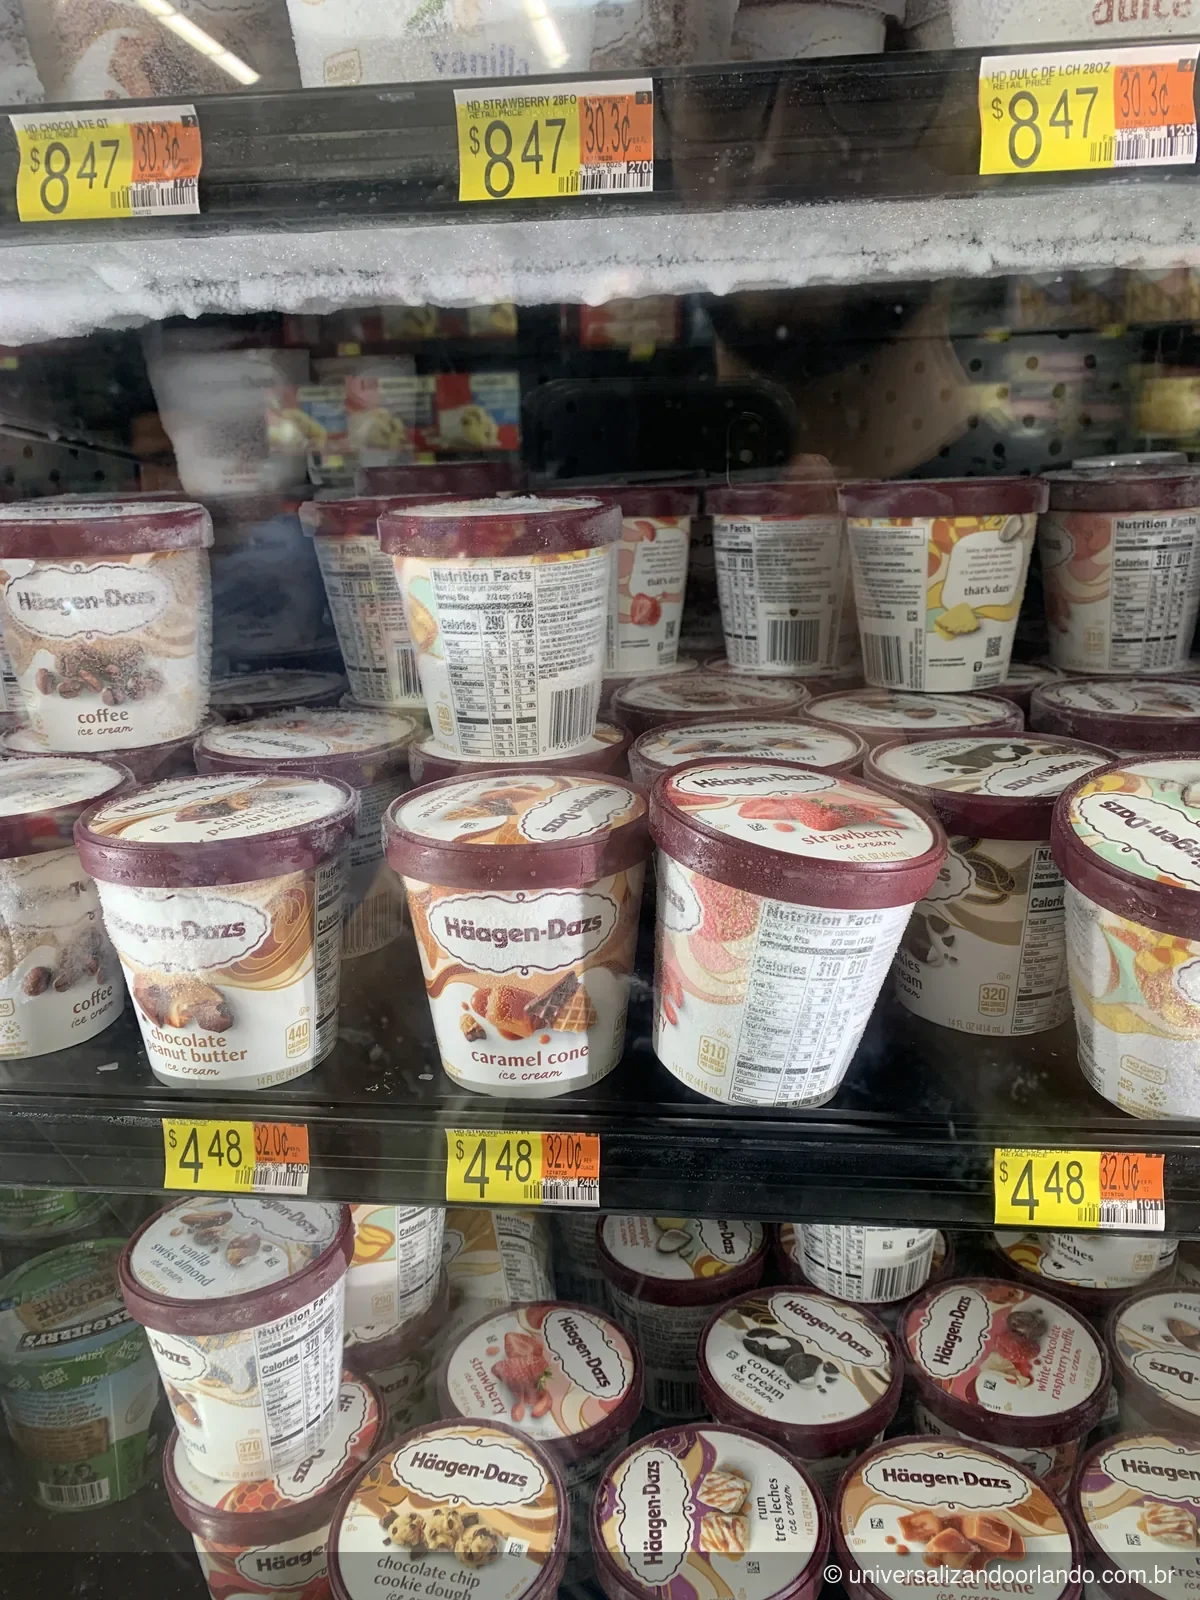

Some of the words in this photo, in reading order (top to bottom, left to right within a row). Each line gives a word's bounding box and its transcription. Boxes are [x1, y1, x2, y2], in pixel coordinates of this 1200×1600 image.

[992, 71, 1006, 83] HD
[1008, 68, 1039, 81] DULC
[1041, 66, 1056, 78] DE
[1058, 64, 1081, 77] LCH
[1083, 61, 1111, 74] 28OZ
[993, 80, 1023, 90] RETAIL
[1025, 77, 1052, 88] PRICE
[467, 101, 481, 110] HD
[483, 96, 550, 110] STRAWBERRY
[552, 94, 577, 106] 28FO
[41, 119, 96, 131] CHOCOLATE
[1116, 519, 1167, 530] Nutrition
[1156, 554, 1172, 565] 310
[433, 571, 488, 582] Nutrition
[494, 570, 532, 581] Facts
[78, 708, 129, 724] coffee
[78, 727, 94, 736] ice
[97, 725, 133, 735] cream
[692, 772, 822, 788] Häagen-Dazs
[801, 828, 903, 845] strawberry
[835, 843, 854, 851] ice
[857, 840, 896, 849] cream
[765, 904, 842, 926] Nutrition
[848, 913, 884, 926] Facts
[444, 914, 602, 949] Häagen-Dazs
[817, 961, 841, 976] 310
[847, 958, 868, 976] 810
[73, 983, 113, 1014] coffee
[982, 987, 1006, 1000] 320
[71, 1016, 88, 1029] ice
[90, 1001, 115, 1020] cream
[151, 1027, 227, 1047] chocolate
[288, 1022, 308, 1041] 440
[191, 1048, 249, 1063] butter
[471, 1050, 541, 1067] caramel
[547, 1045, 589, 1065] cone
[702, 1039, 726, 1060] 310
[165, 1062, 178, 1073] ice
[182, 1065, 220, 1076] cream
[498, 1069, 517, 1081] ice
[521, 1069, 563, 1081] cream
[287, 1163, 308, 1173] 1400
[1137, 1199, 1162, 1210] 1011
[179, 1244, 210, 1267] vanilla
[1056, 1239, 1094, 1263] leches
[151, 1243, 178, 1262] swiss
[174, 1256, 216, 1287] almond
[257, 1309, 310, 1338] Nutrition
[783, 1300, 873, 1359] Häagen-Dazs
[932, 1295, 972, 1366] Häagen-Dazs
[262, 1352, 299, 1375] Calories
[304, 1336, 320, 1354] 370
[557, 1316, 611, 1389] Häagen-Dazs
[1041, 1323, 1062, 1366] chocolate
[1051, 1353, 1071, 1401] raspberry
[1062, 1327, 1075, 1354] truffle
[1072, 1347, 1082, 1372] cream
[736, 1364, 747, 1375] &
[747, 1371, 785, 1401] cream
[747, 1357, 794, 1391] cookies
[1036, 1367, 1048, 1393] white
[469, 1357, 507, 1416] strawberry
[471, 1384, 486, 1409] cream
[731, 1372, 745, 1385] ice
[746, 1382, 775, 1404] cream
[238, 1441, 260, 1453] 370
[409, 1451, 529, 1489] Häagen-Dazs
[882, 1467, 1012, 1491] Häagen-Dazs
[768, 1477, 785, 1514] leches
[782, 1484, 794, 1516] cream
[643, 1459, 668, 1566] Häagen-Dazs
[757, 1496, 769, 1521] rum
[774, 1516, 787, 1543] tres
[789, 1523, 797, 1535] ice
[377, 1554, 447, 1581] chocolate
[450, 1567, 481, 1589] chip
[373, 1572, 423, 1593] cookie
[425, 1579, 473, 1600] dough
